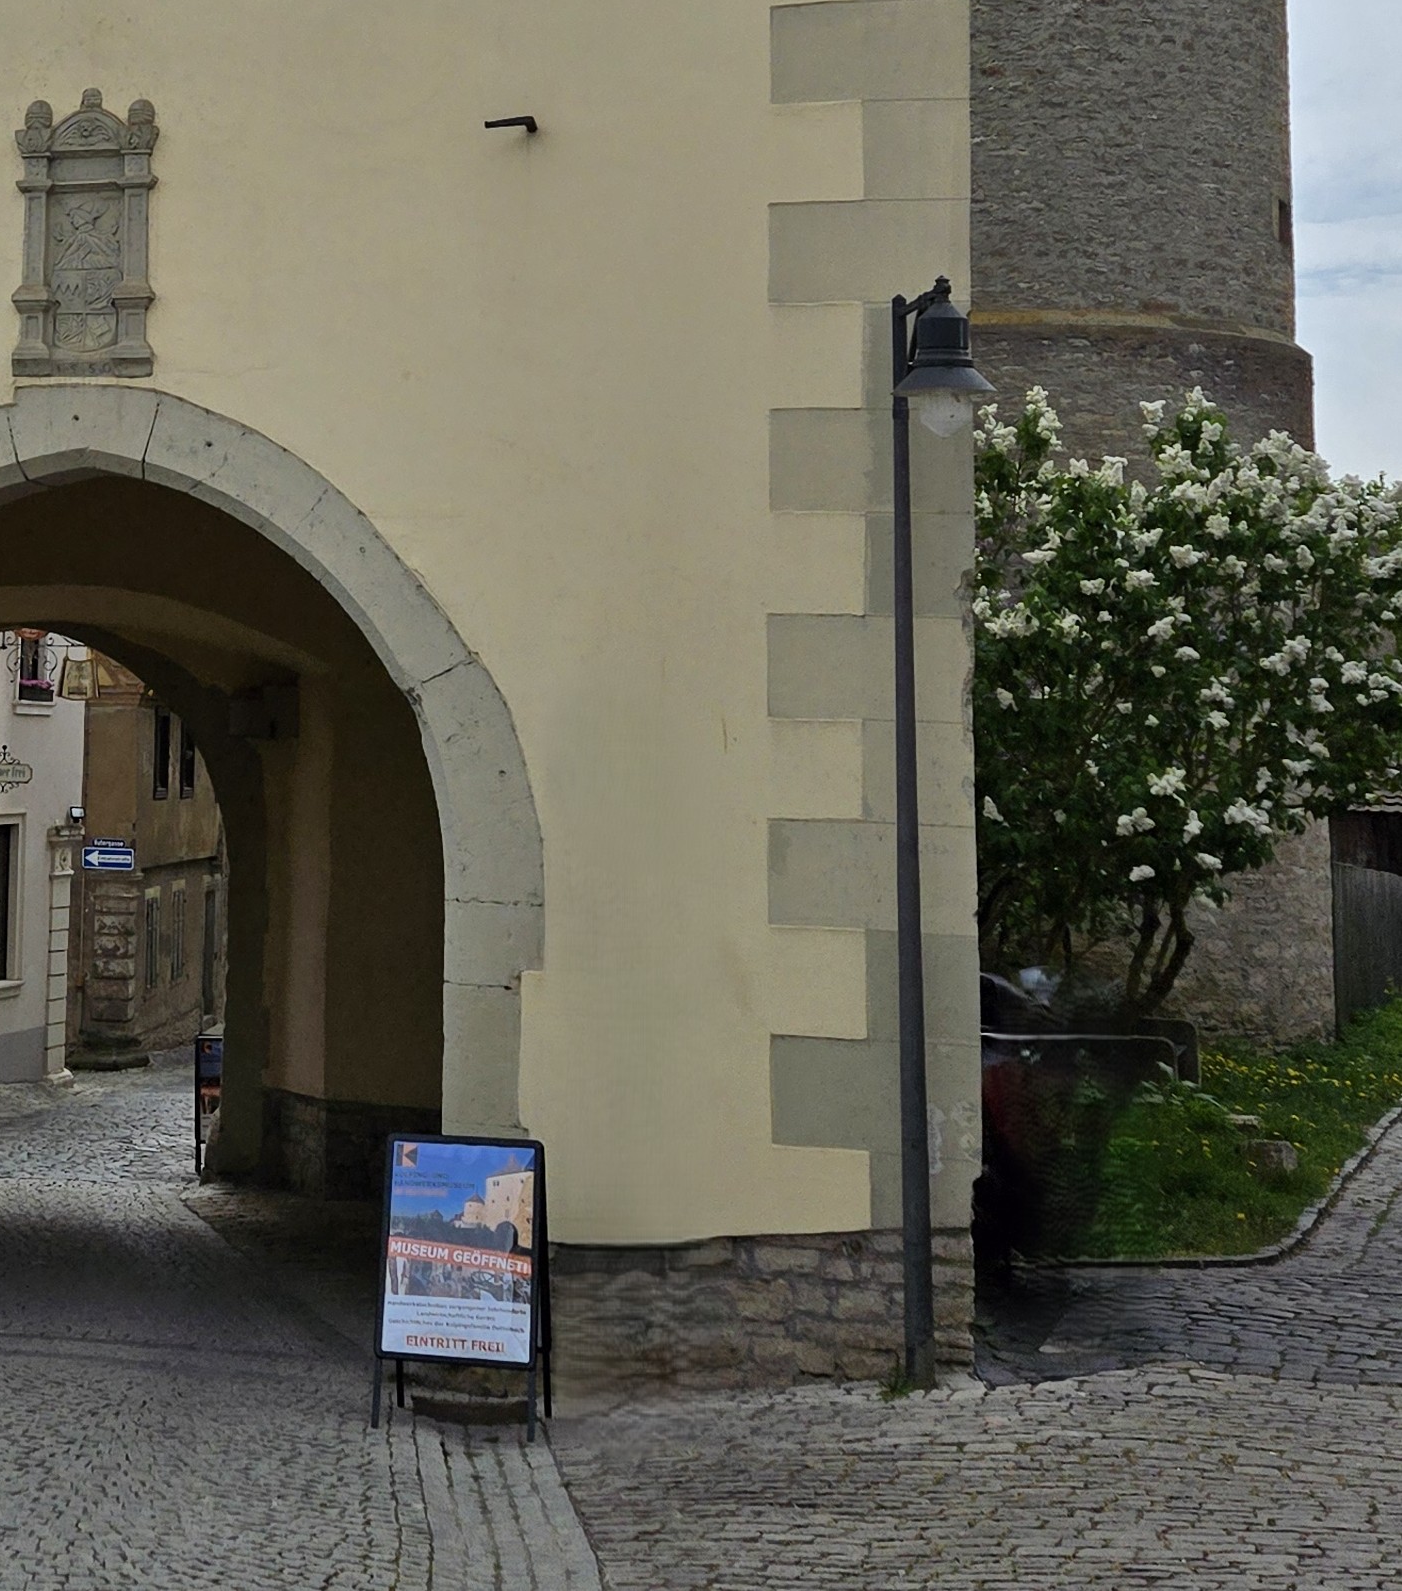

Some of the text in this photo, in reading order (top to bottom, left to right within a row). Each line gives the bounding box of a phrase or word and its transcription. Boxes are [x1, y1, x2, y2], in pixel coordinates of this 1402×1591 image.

[390, 1241, 449, 1261] MUSEUM
[406, 1335, 505, 1353] EINTRITT FREI!
